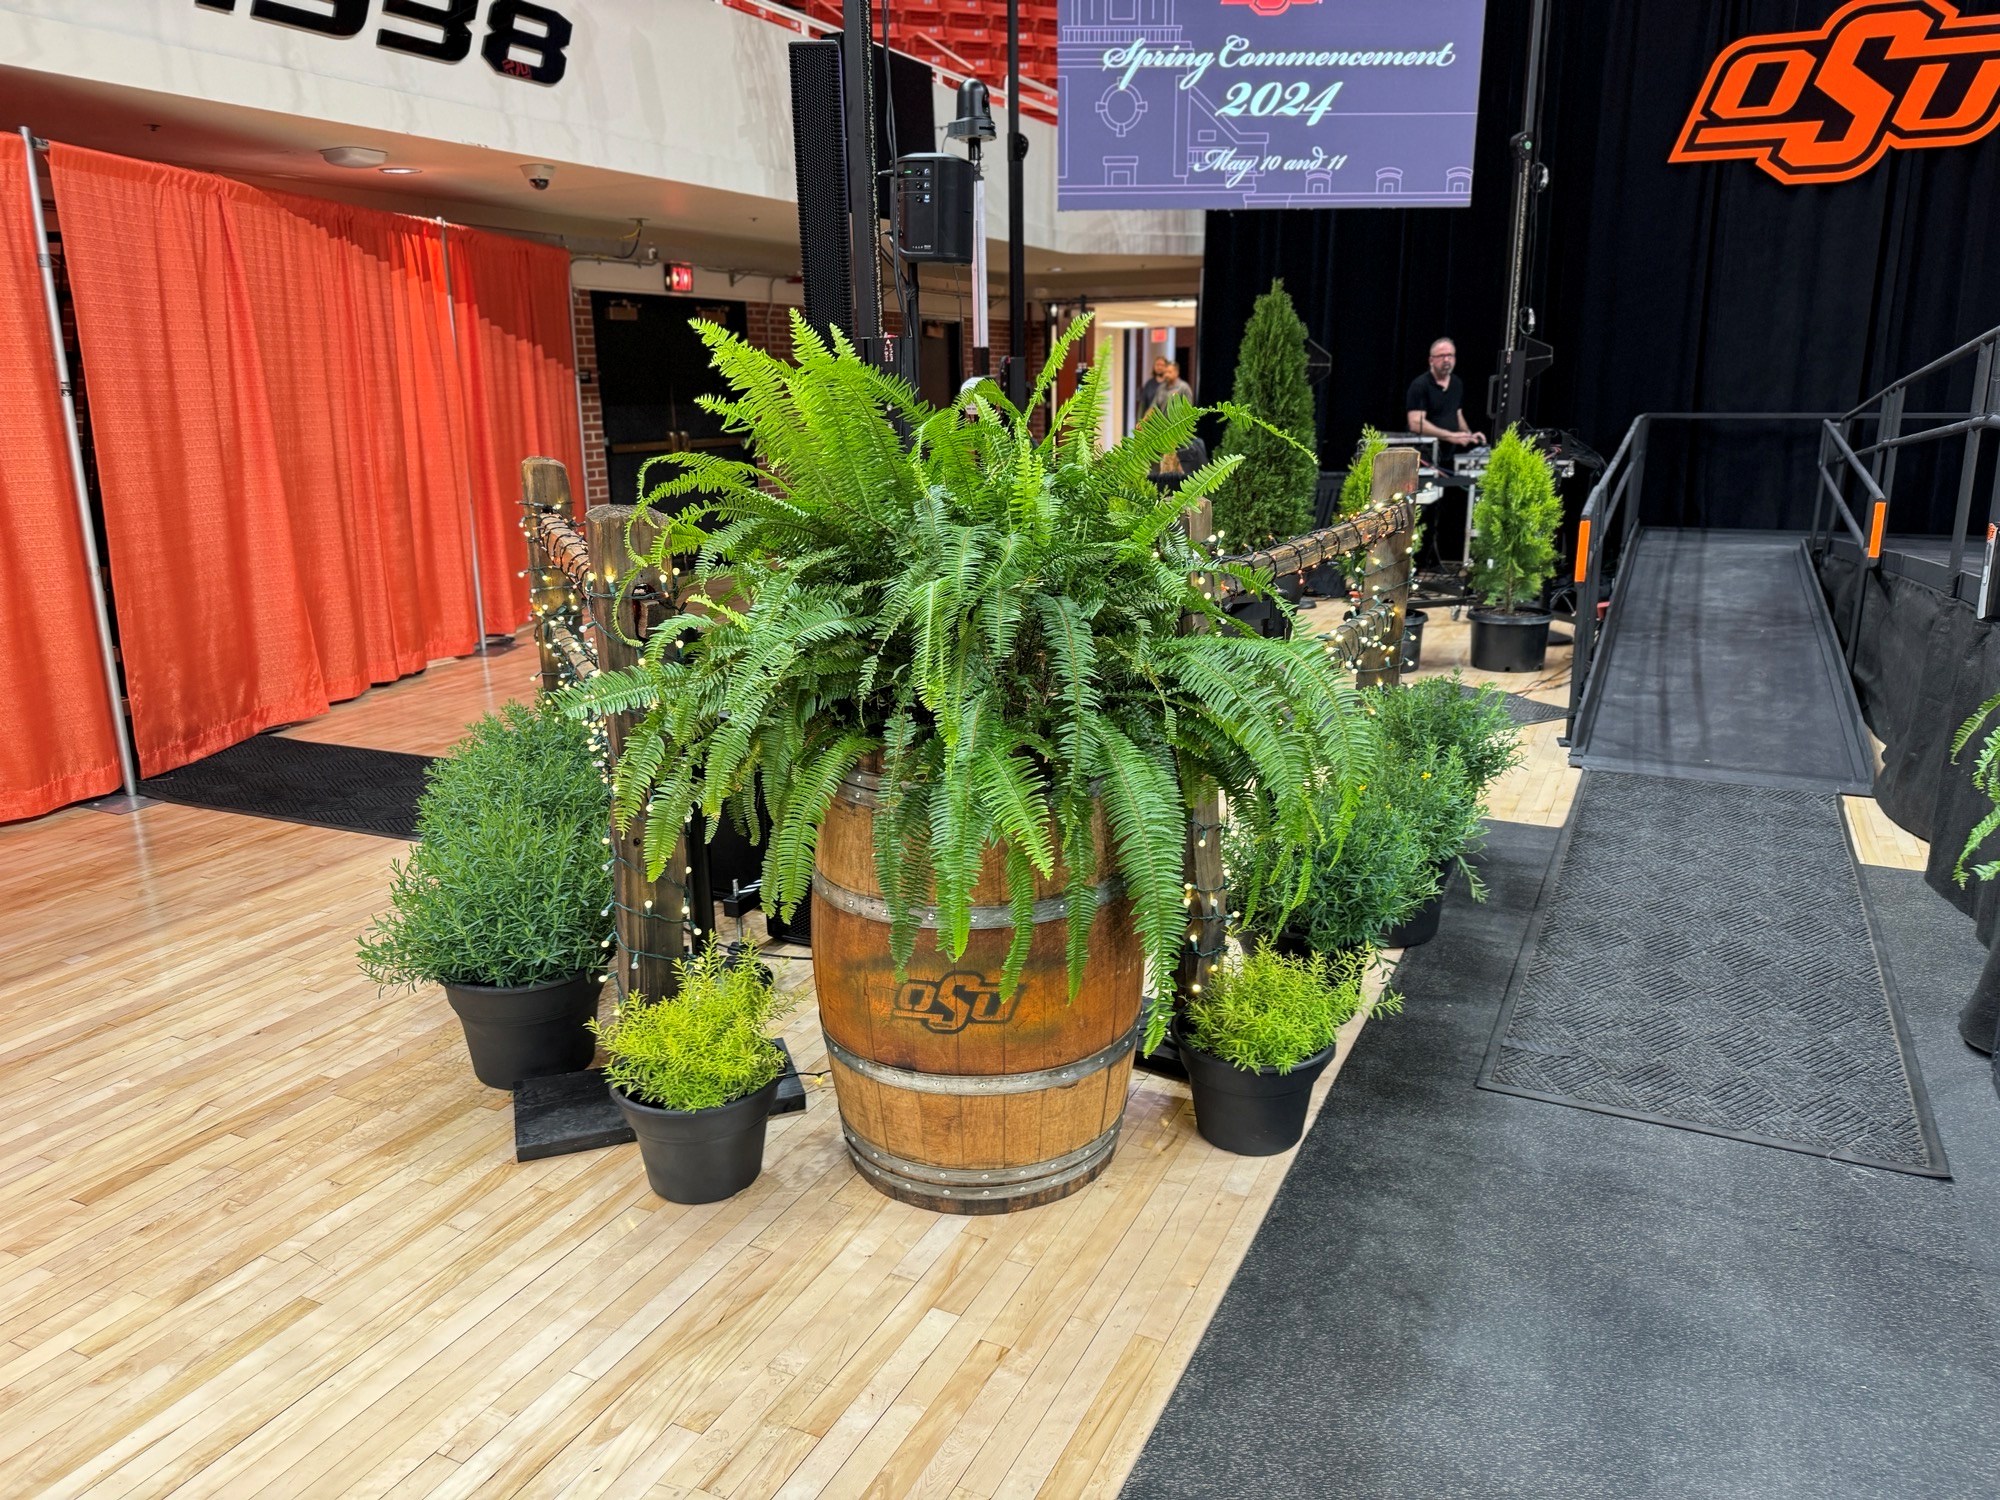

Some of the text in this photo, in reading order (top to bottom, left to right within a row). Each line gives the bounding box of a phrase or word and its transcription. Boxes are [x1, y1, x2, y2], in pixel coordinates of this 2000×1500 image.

[1102, 34, 1456, 91] Spring Commencement
[1214, 81, 1344, 127] 2024
[1667, 0, 2000, 185] OSU
[1193, 146, 1348, 189] May 10 and 11
[891, 970, 1028, 1035] OSU
